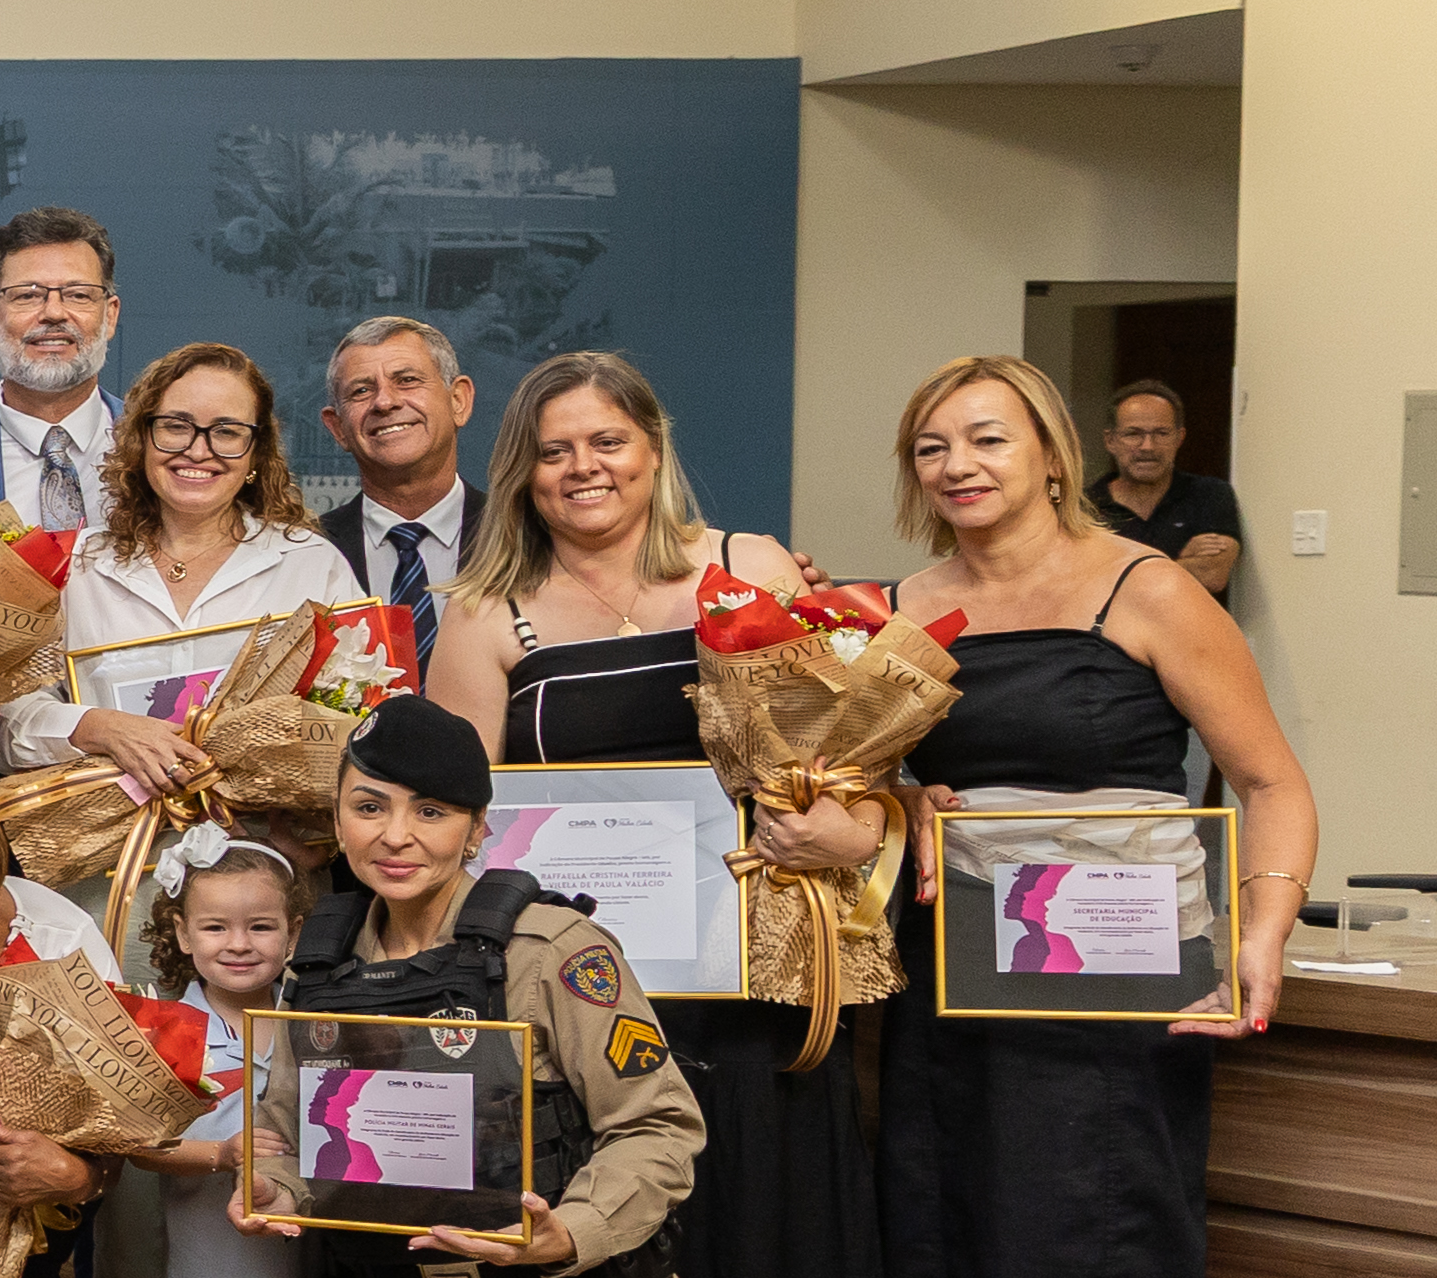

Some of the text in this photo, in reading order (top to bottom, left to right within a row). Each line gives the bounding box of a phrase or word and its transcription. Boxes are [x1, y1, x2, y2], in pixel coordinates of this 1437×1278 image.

[1, 606, 52, 635] YOU
[879, 659, 937, 700] YOU
[568, 819, 597, 827] CMPA
[589, 871, 629, 879] CRISTINA
[549, 881, 578, 889] VILELA
[625, 879, 665, 887] VALÁCIO
[1101, 915, 1142, 923] EDUCAÇÃO
[65, 957, 109, 1009] YOU
[28, 996, 74, 1039] YOU
[387, 1079, 408, 1087] CMPA
